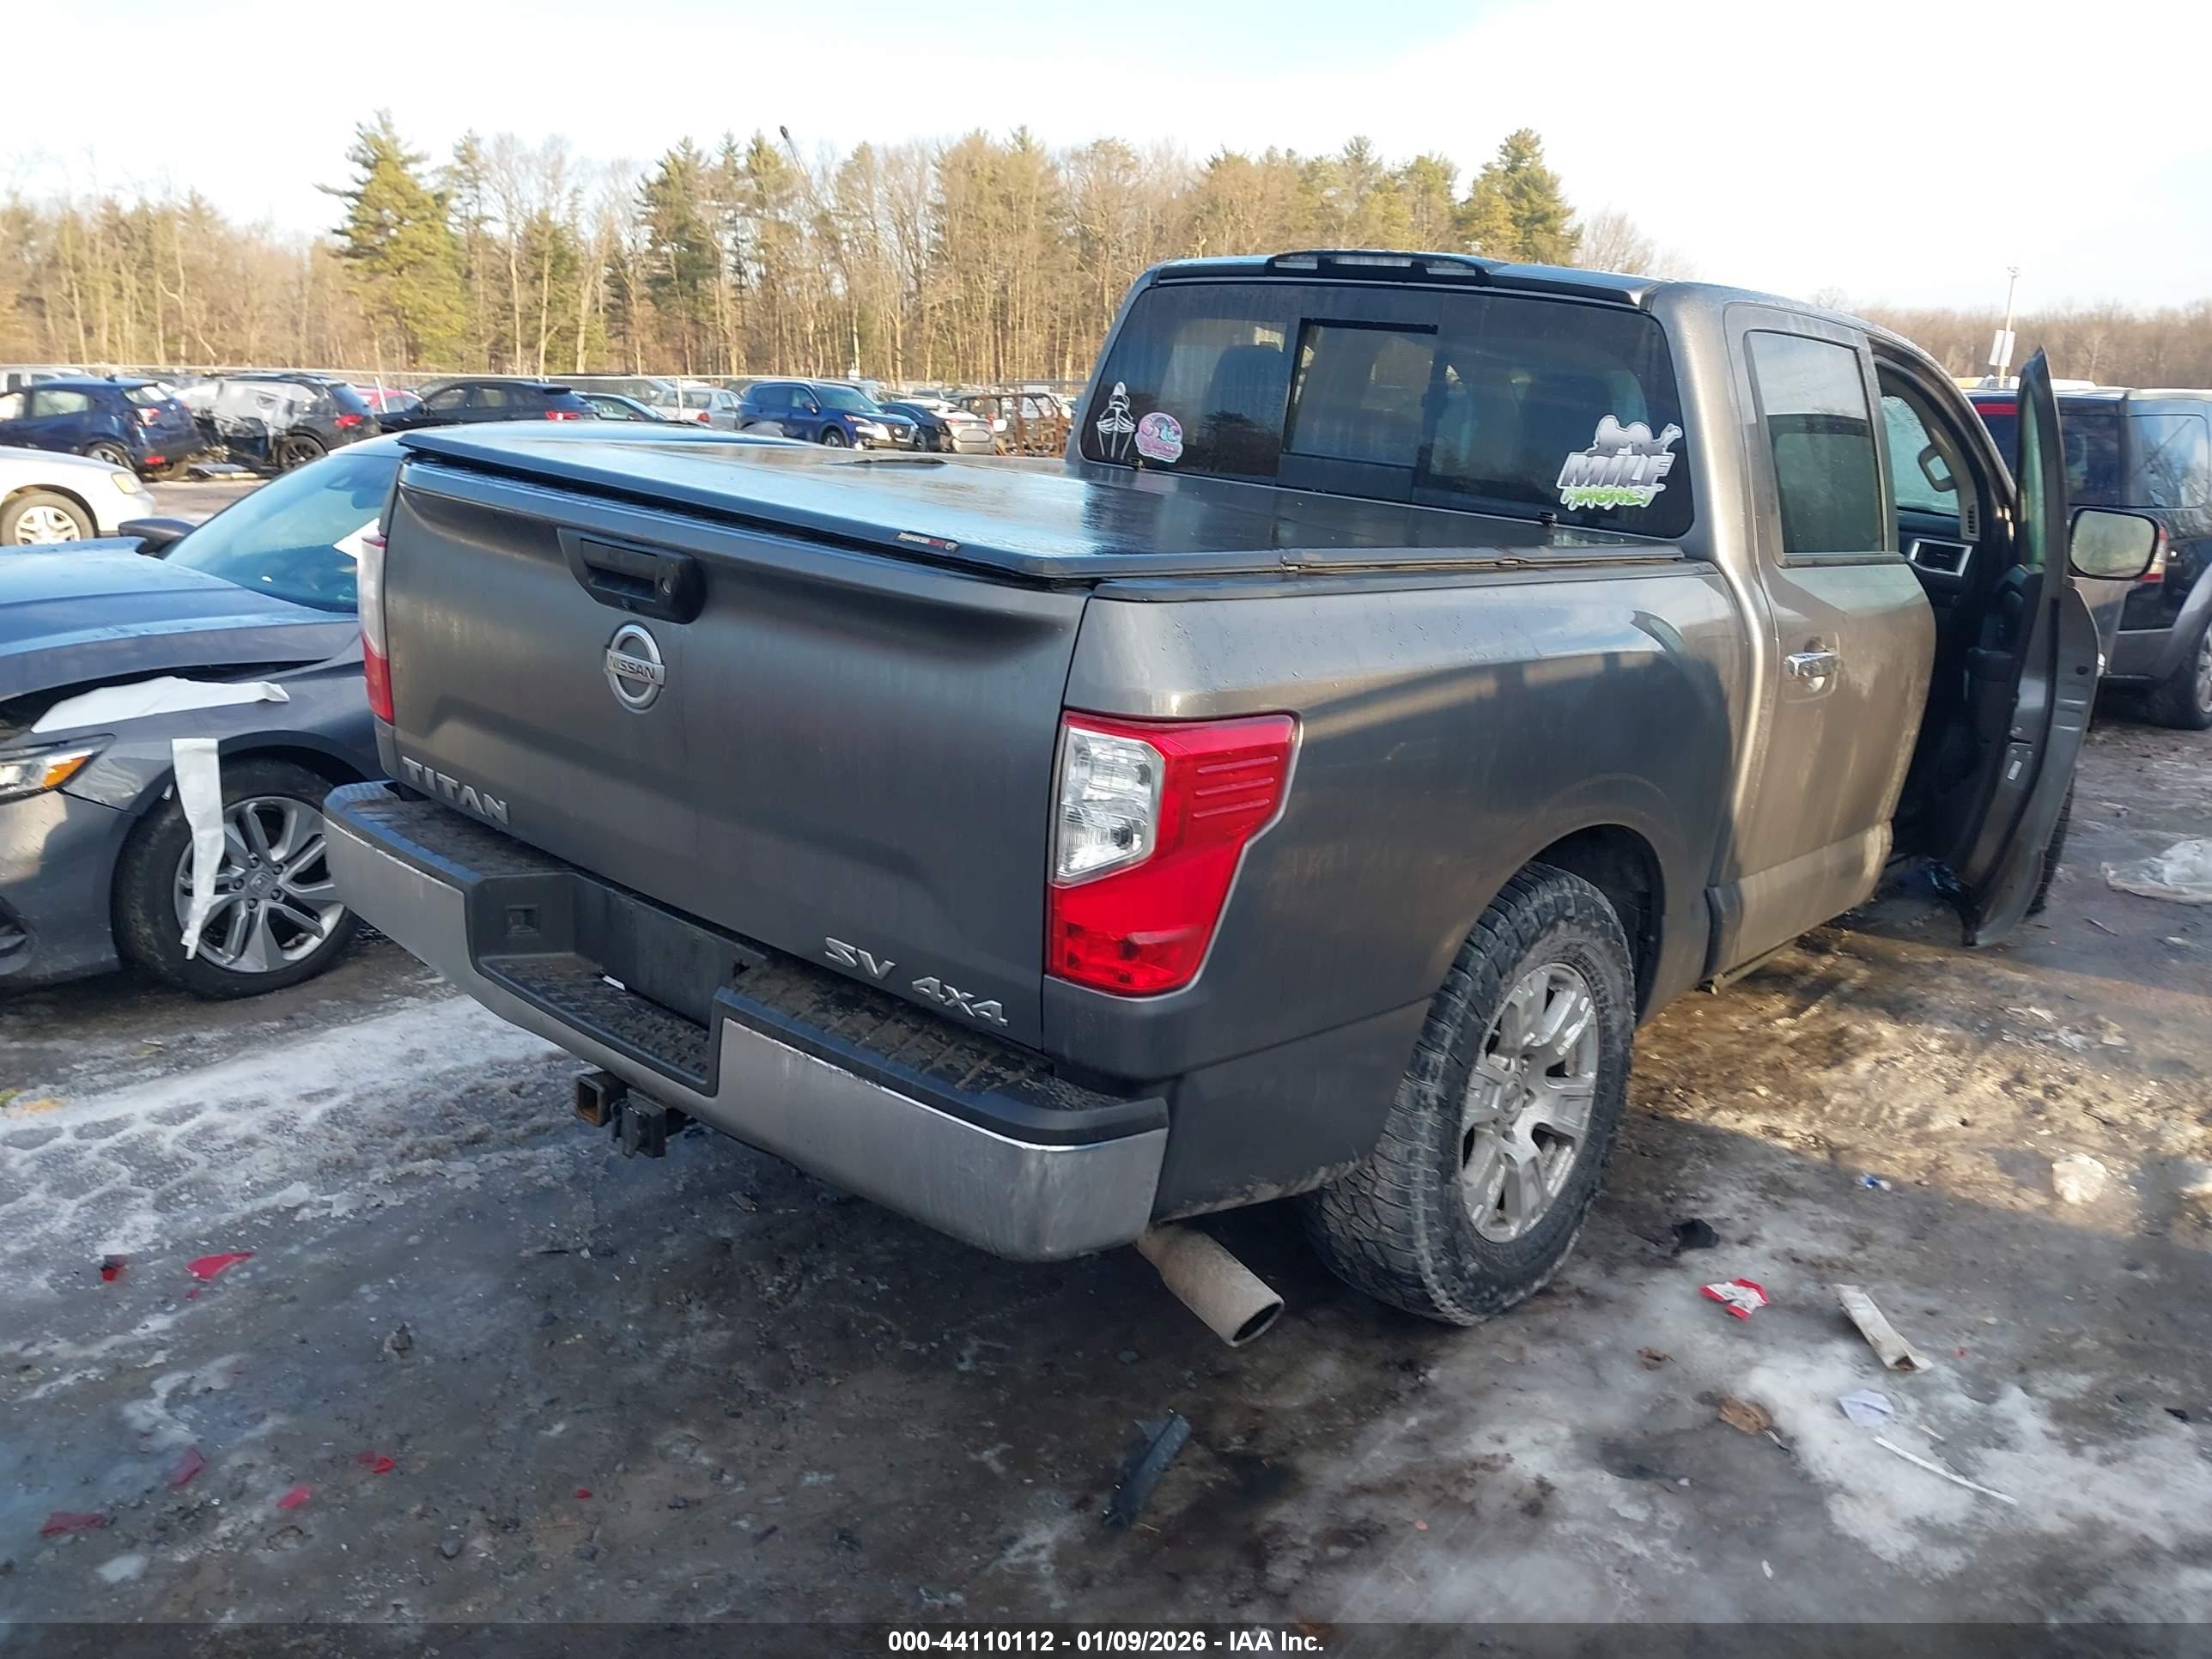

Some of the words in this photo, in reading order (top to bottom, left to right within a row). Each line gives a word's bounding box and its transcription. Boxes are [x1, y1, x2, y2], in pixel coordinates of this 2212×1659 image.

[1560, 455, 1674, 487] MILF
[609, 654, 656, 681] NISSAN
[401, 755, 510, 825] TITAN
[824, 936, 896, 981] SV
